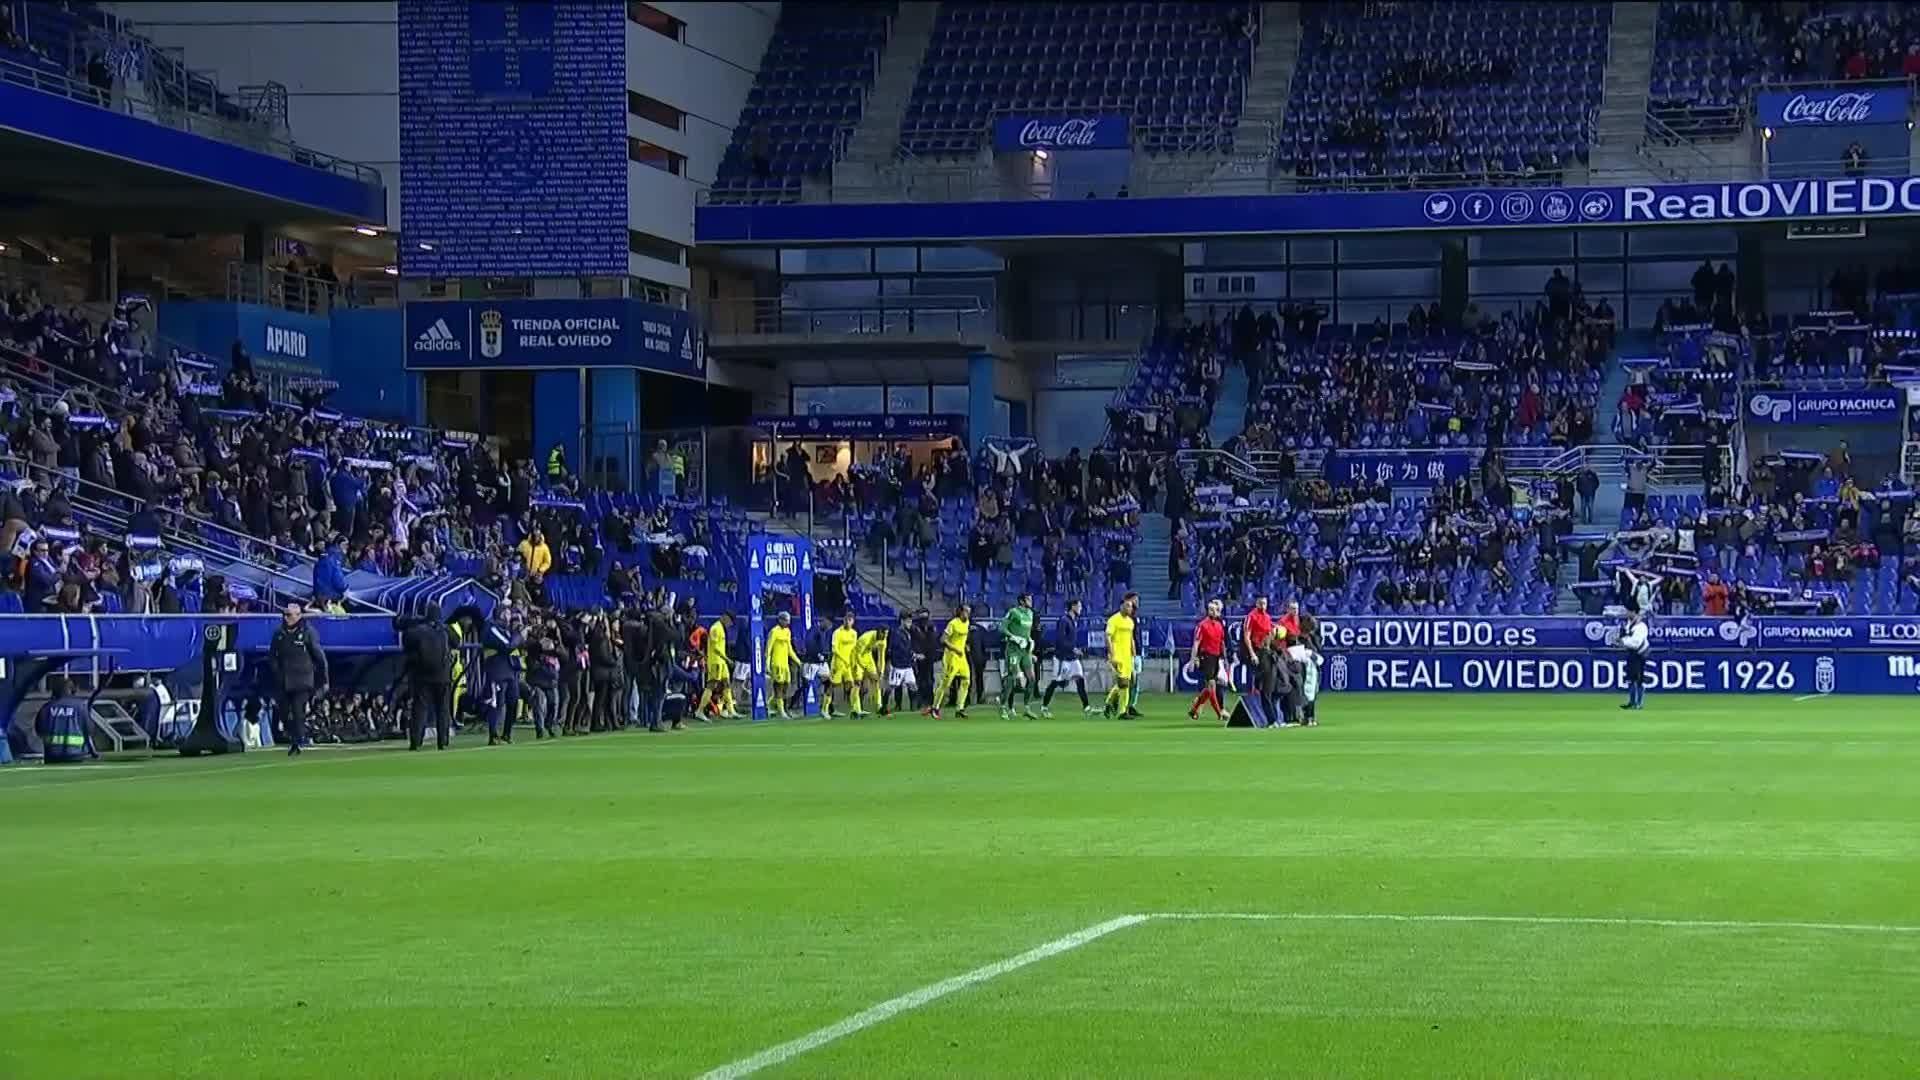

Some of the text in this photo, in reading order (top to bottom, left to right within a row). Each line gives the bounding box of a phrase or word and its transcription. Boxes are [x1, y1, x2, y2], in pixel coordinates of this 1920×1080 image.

[511, 317, 620, 331] TIENDA OFICIAL
[266, 326, 307, 358] APARO
[413, 339, 461, 350] adidas
[519, 334, 612, 347] REAL OVIEDO
[1798, 399, 1838, 411] GRUPO
[1839, 398, 1896, 410] PACHUCA
[1349, 461, 1446, 481] 以你为傲
[1319, 621, 1537, 646] RealOVIEDO.es
[1665, 627, 1715, 638] PACHUCA
[1763, 627, 1800, 638] GRUPO
[1802, 626, 1853, 638] PACHUCA
[1869, 623, 1889, 638] EL
[1367, 660, 1795, 689] REAL OVIEDO DESDE 1926
